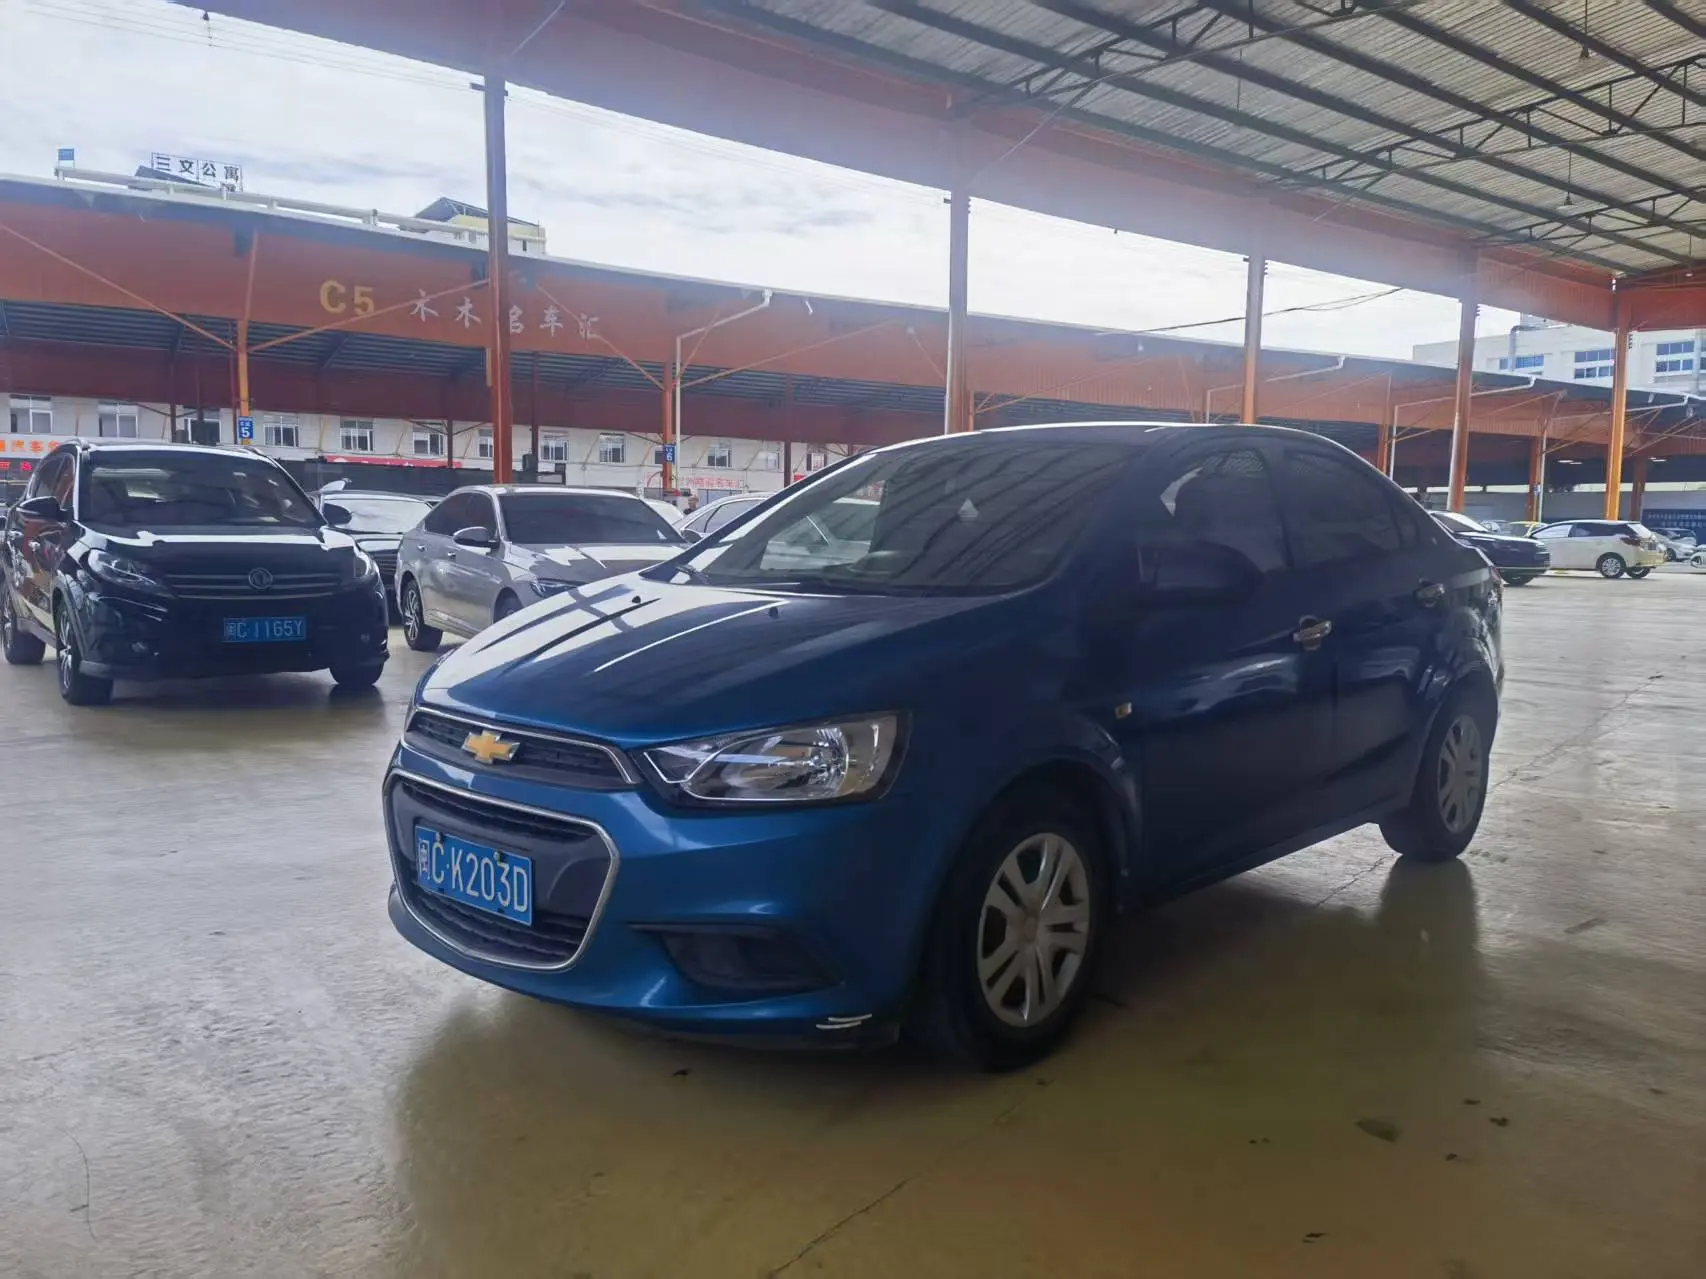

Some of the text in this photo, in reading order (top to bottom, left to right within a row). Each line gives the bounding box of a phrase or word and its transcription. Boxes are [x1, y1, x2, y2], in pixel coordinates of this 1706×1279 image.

[156, 155, 239, 183] 三文公寓
[319, 279, 375, 316] C5
